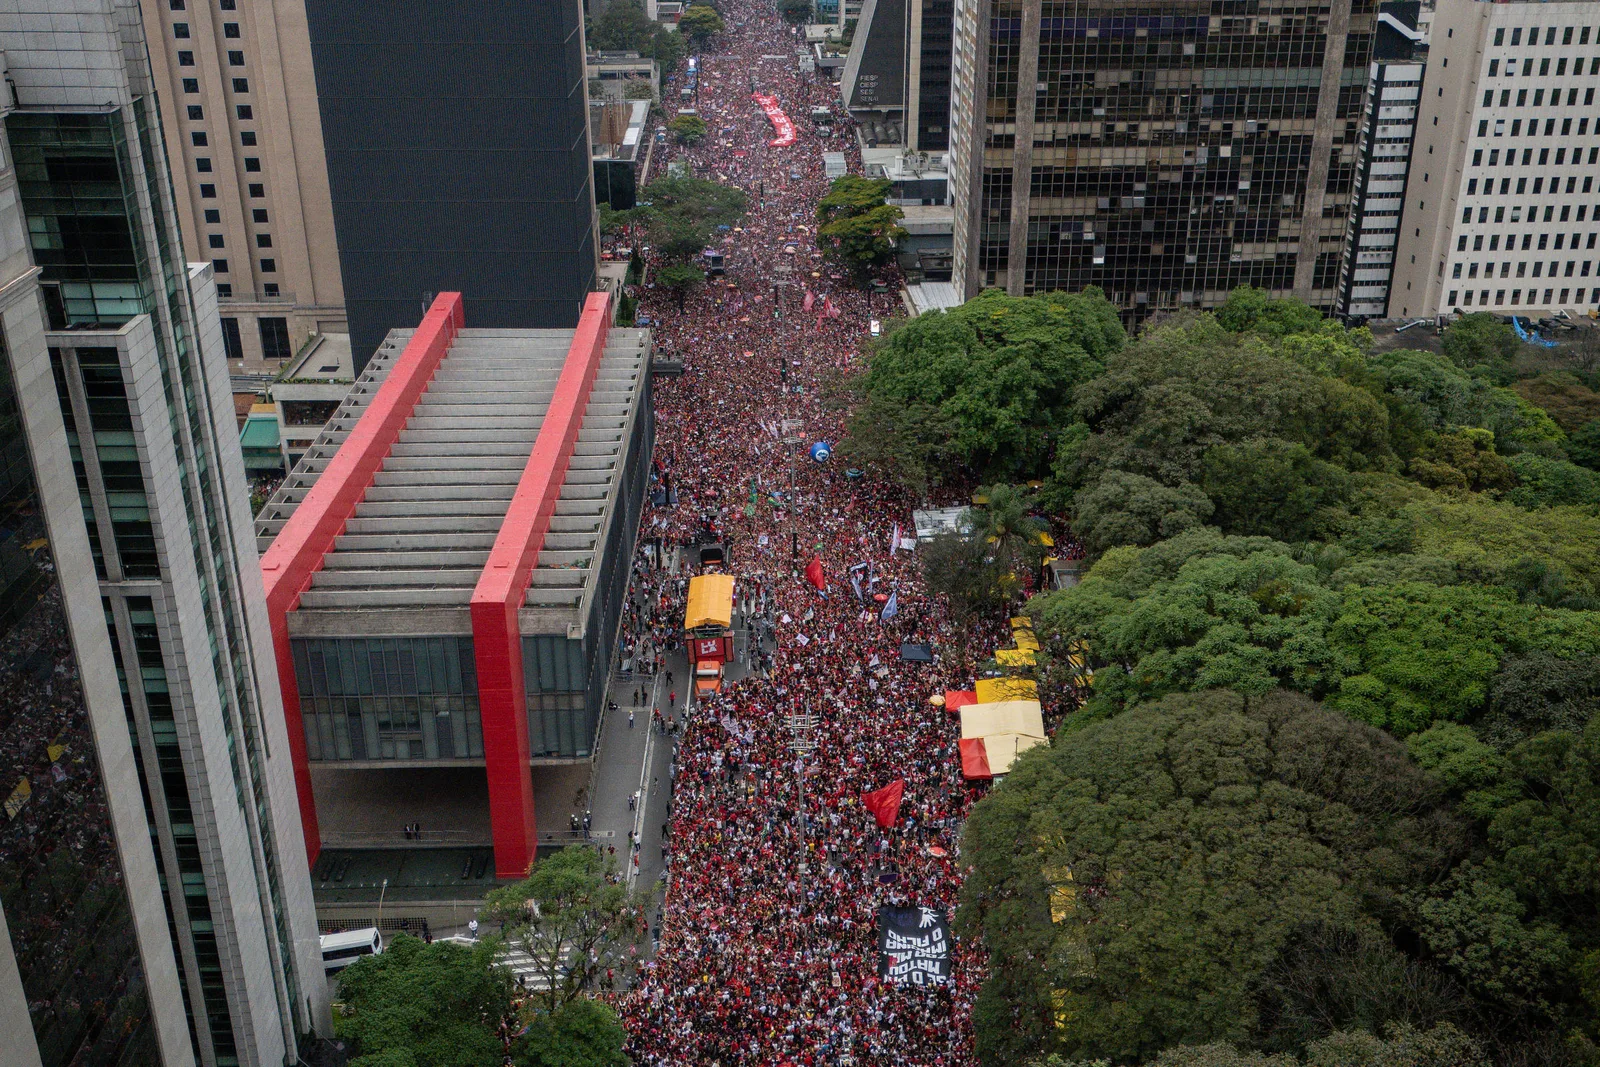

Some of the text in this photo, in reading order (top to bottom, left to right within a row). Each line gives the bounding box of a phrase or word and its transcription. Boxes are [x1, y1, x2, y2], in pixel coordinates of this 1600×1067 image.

[888, 927, 942, 947] O FILHO
[889, 960, 940, 974] MATOU
